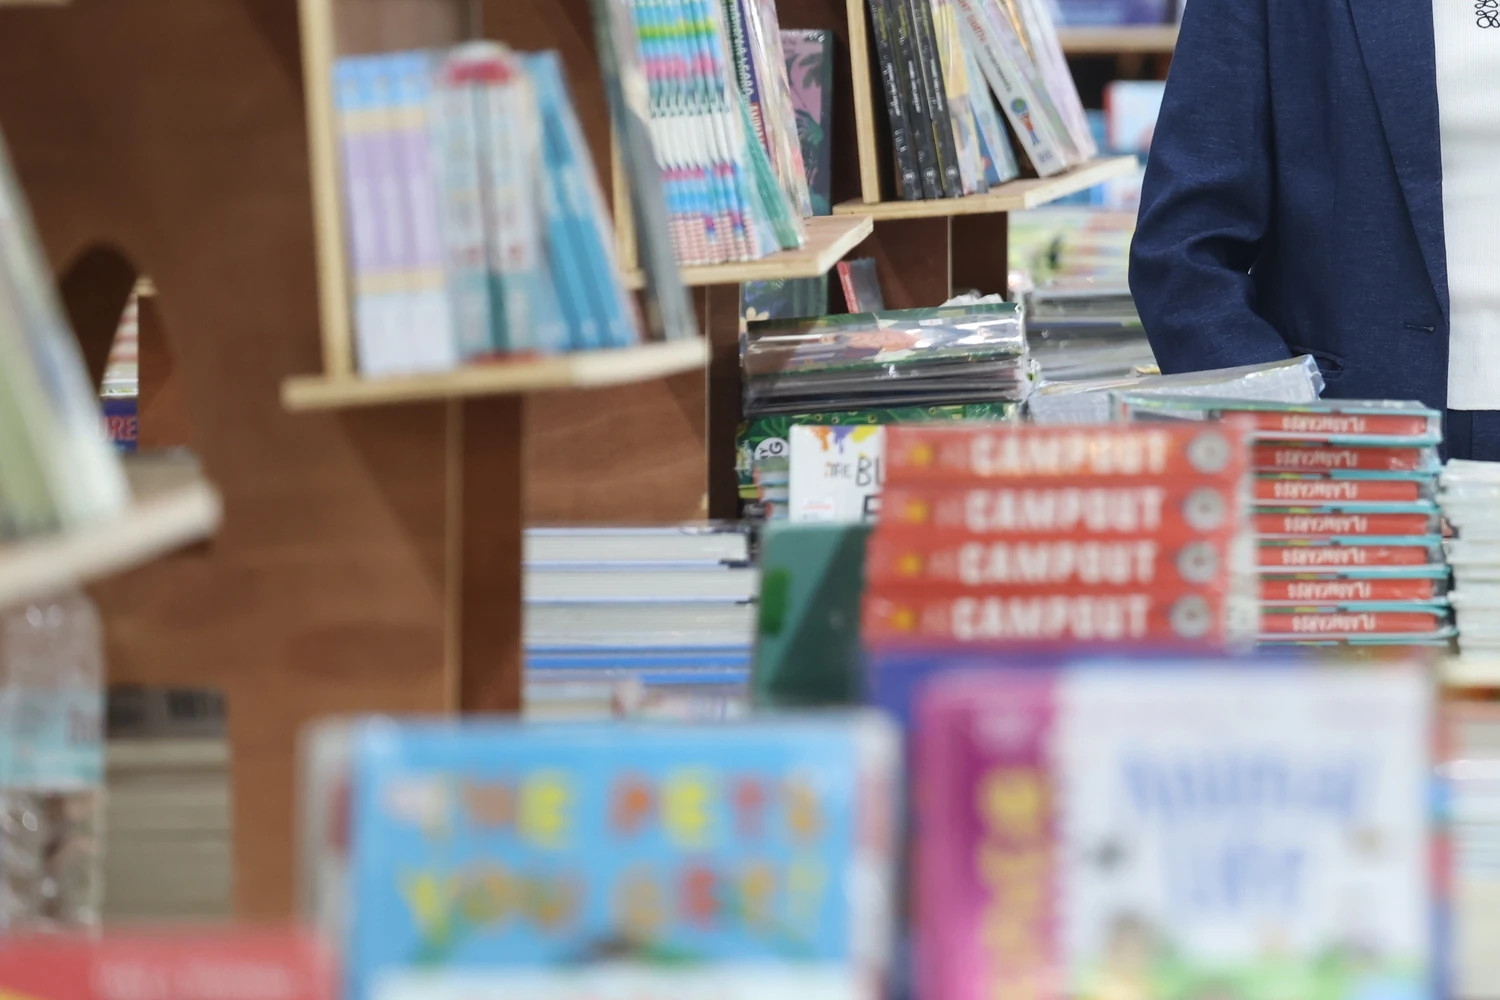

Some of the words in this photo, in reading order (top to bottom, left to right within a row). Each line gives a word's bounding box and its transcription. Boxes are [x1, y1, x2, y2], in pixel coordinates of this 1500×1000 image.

[969, 430, 1168, 477] CAMPOUT
[964, 486, 1165, 534] CAMPOUT
[957, 539, 1157, 585] CAMPOUT
[950, 594, 1150, 641] CAMPOUT
